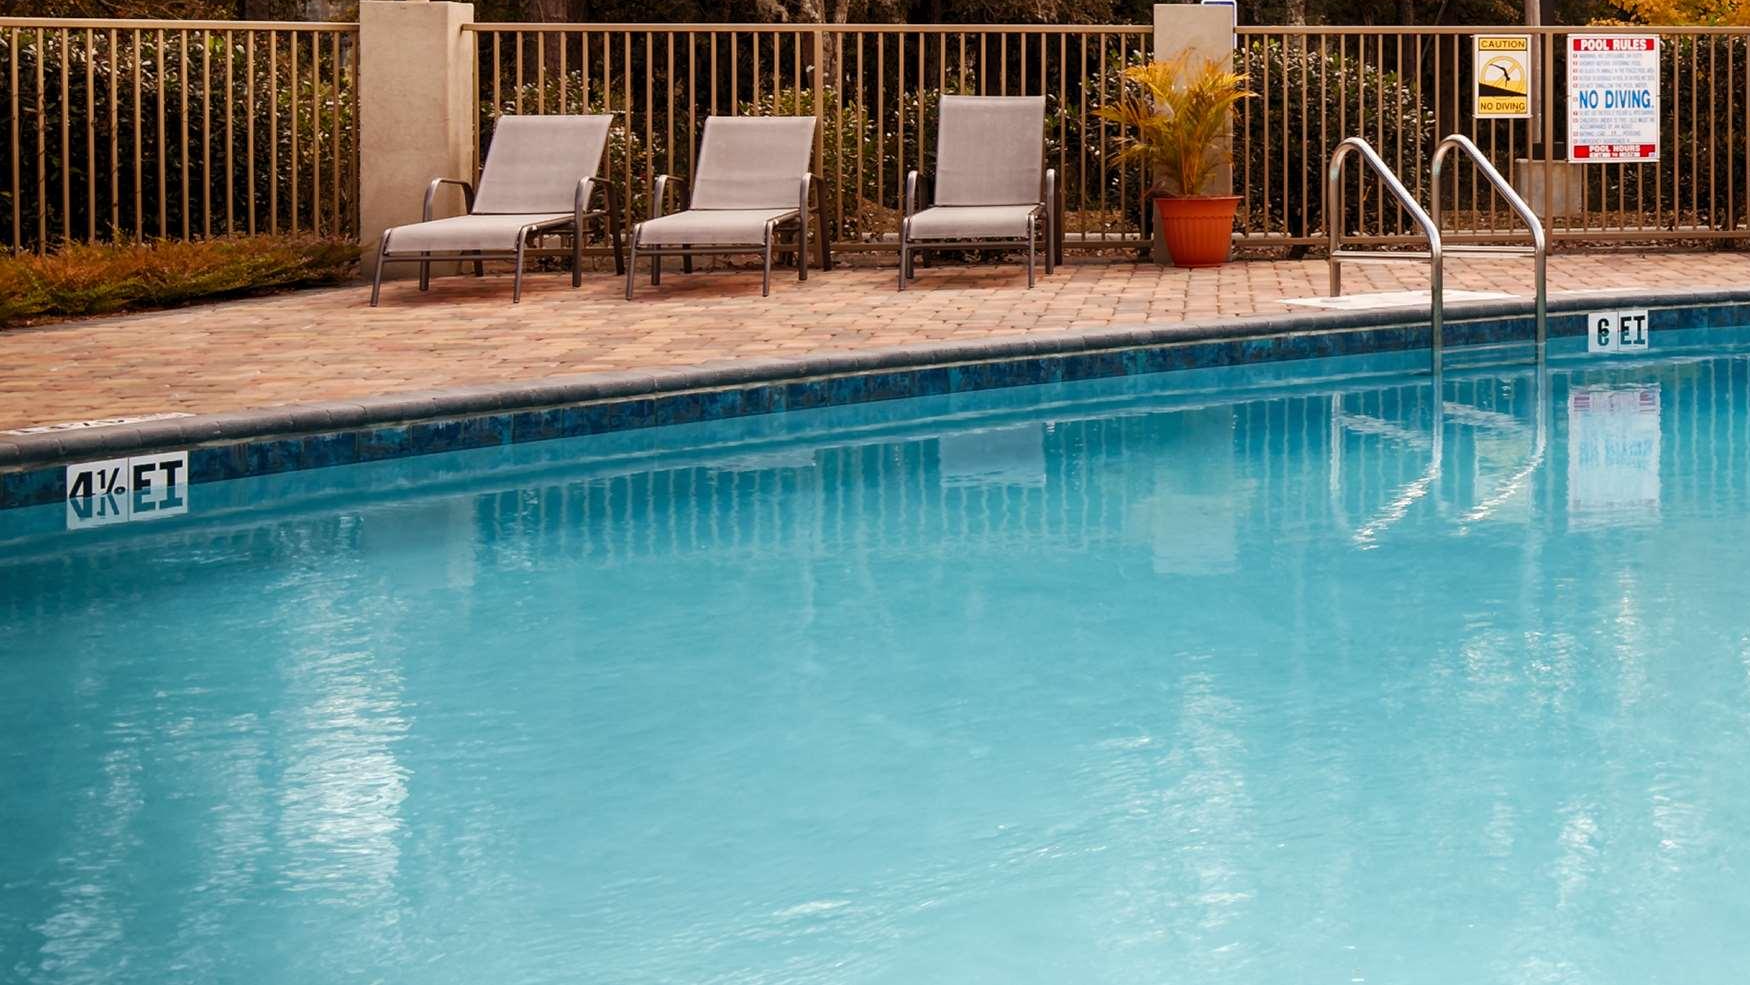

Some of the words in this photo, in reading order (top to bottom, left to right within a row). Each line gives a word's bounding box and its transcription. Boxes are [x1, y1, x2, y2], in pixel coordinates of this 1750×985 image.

[1480, 40, 1525, 48] CAUTION
[1580, 39, 1610, 51] POOL
[1613, 39, 1647, 51] RULES
[1579, 89, 1599, 109] NO
[1480, 102, 1493, 111] NO
[1496, 102, 1525, 111] DIVING
[1589, 144, 1610, 152] POOL
[1613, 144, 1640, 152] HOURS
[1597, 318, 1610, 337] 6
